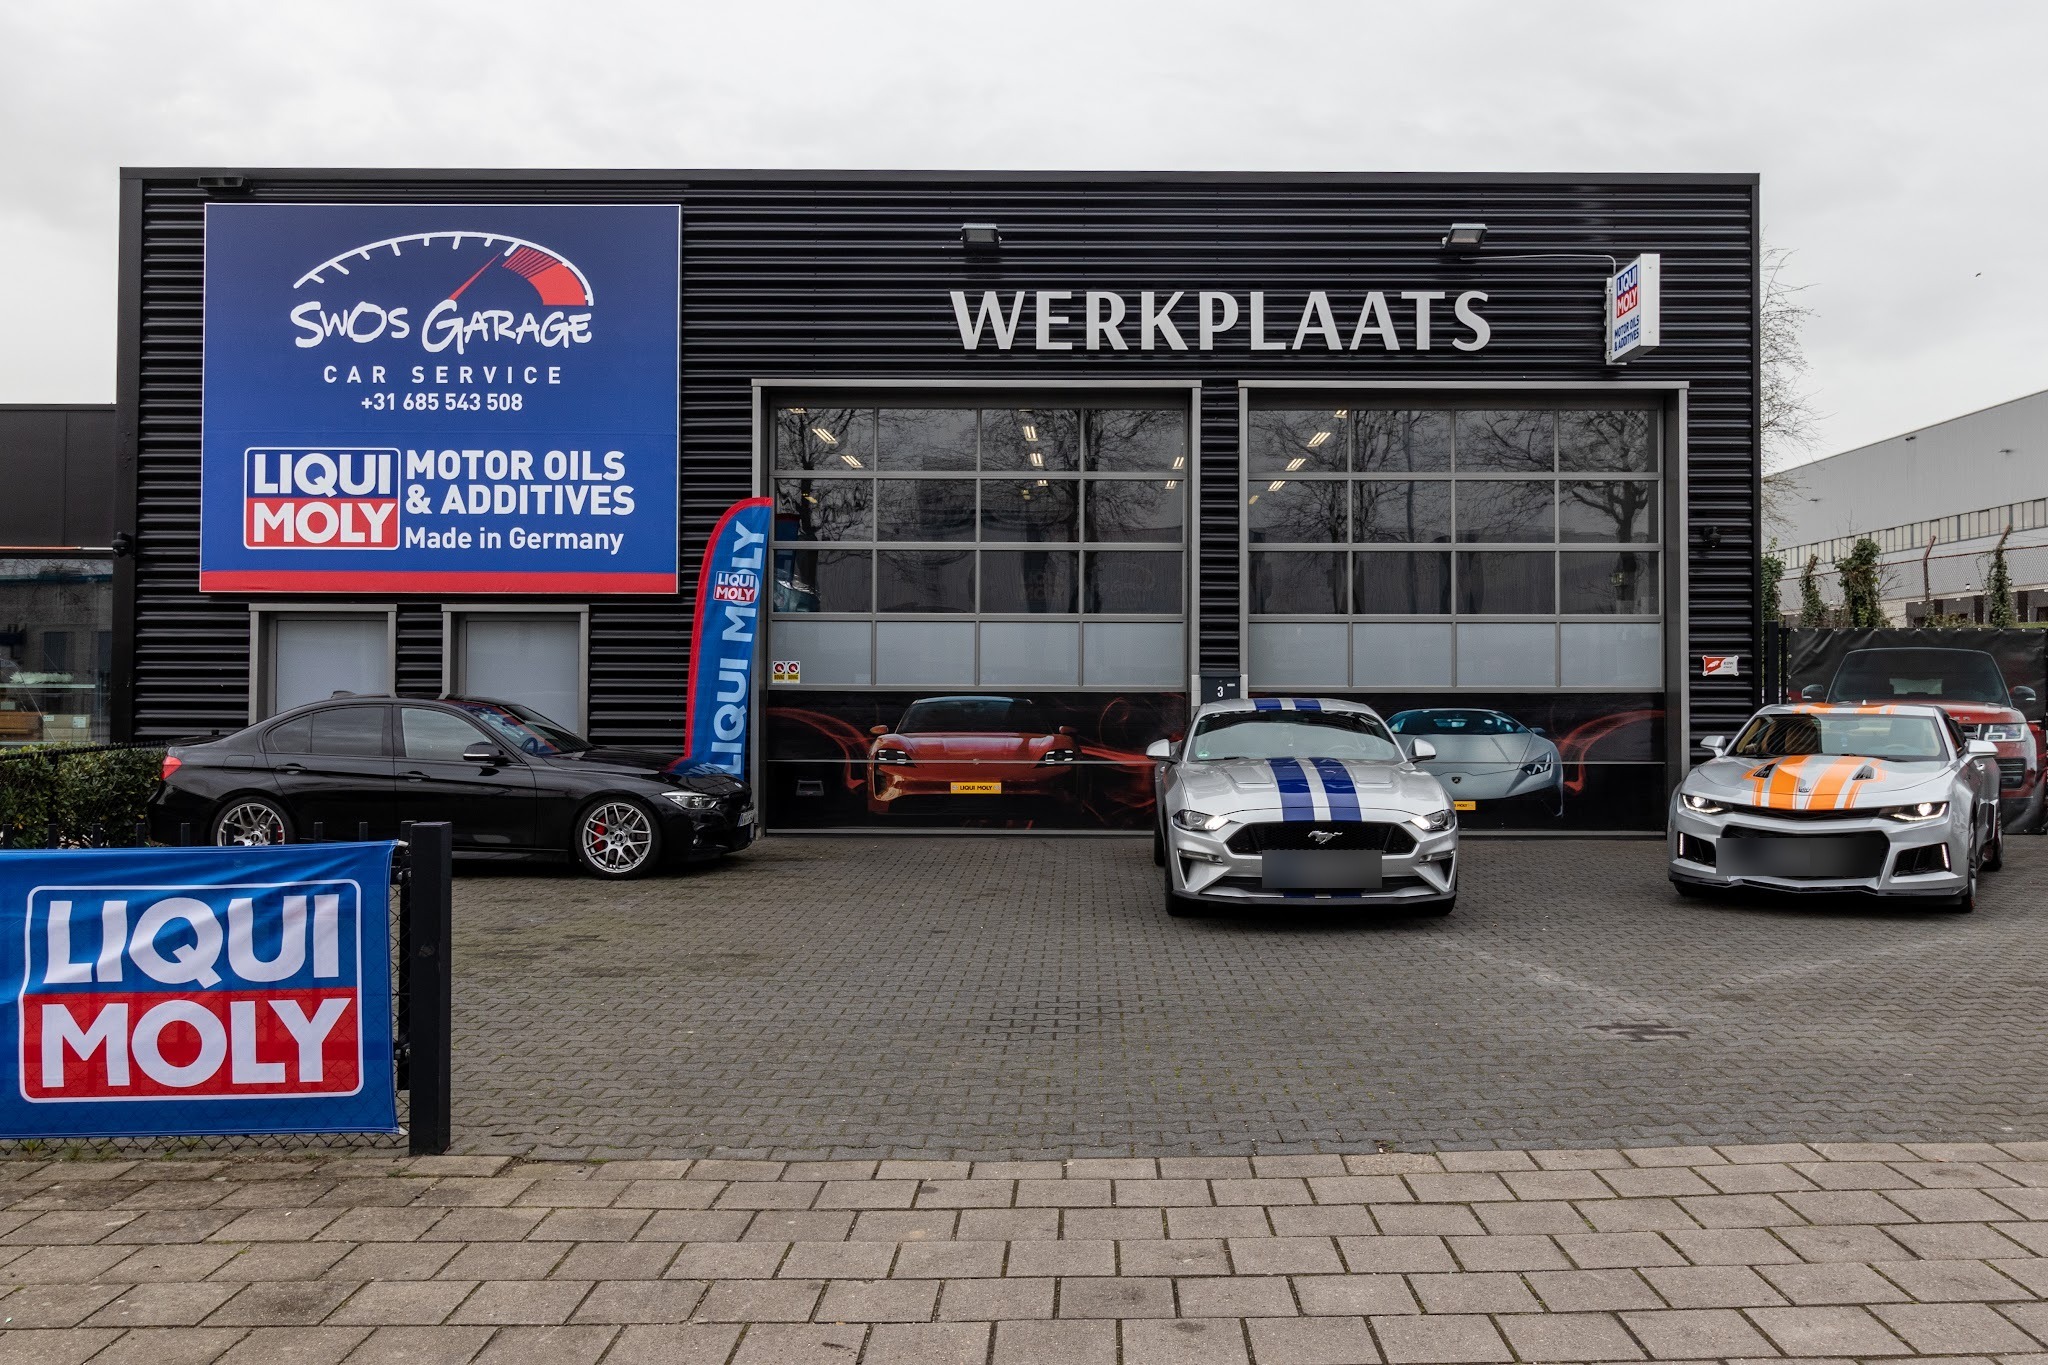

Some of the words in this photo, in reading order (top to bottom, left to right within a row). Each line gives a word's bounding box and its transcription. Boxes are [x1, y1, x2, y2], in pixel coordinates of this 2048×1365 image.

[1617, 266, 1637, 295] LIQUI
[1617, 287, 1637, 316] MOLY
[950, 290, 1491, 351] WERKPLAATS
[323, 365, 387, 384] CAR
[411, 366, 562, 384] SERVICE
[361, 393, 396, 411] +31
[403, 393, 439, 411] 685
[445, 393, 481, 411] 543
[486, 393, 523, 411] 508
[254, 452, 392, 498] LIQUI
[406, 449, 534, 481] MOTOR
[543, 450, 626, 482] OILS
[405, 484, 431, 516] &
[440, 484, 635, 516] ADDITIVES
[253, 501, 396, 544] MOLY
[405, 527, 472, 550] Made
[479, 528, 501, 550] in
[509, 528, 624, 555] Germany
[715, 586, 755, 601] MOLY
[718, 573, 755, 588] LIQUI
[1217, 686, 1224, 698] 3
[711, 658, 748, 775] LIQUI
[43, 894, 340, 988] LIQUI
[42, 998, 352, 1088] MOLY
